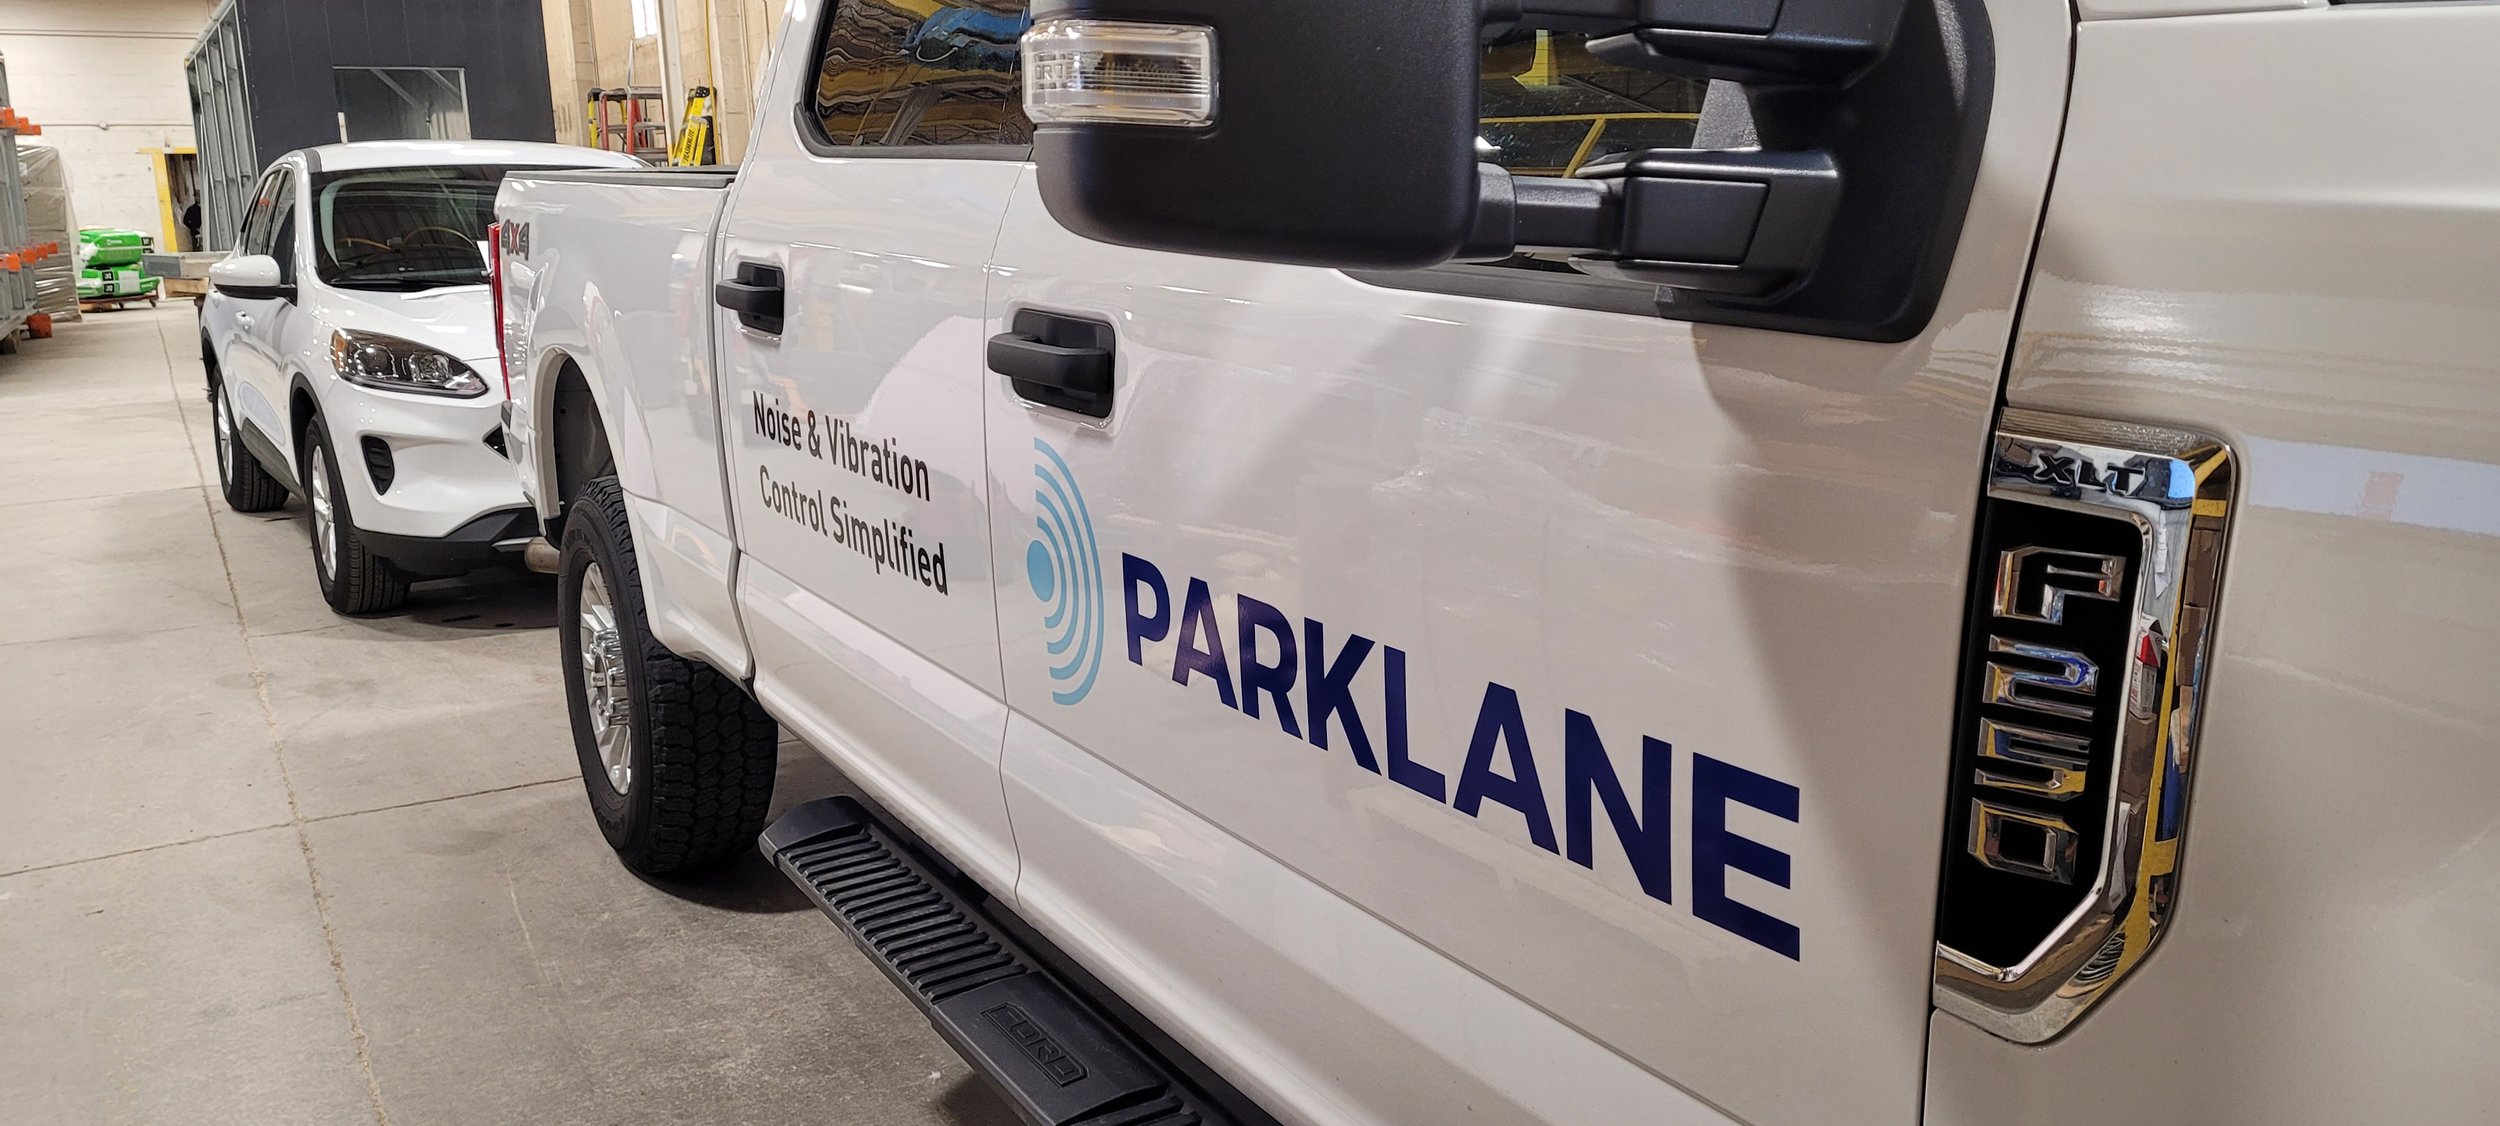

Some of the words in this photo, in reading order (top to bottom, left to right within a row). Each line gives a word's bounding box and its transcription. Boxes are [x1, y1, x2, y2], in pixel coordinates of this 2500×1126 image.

[753, 390, 802, 451] Noise
[807, 409, 823, 460] &
[825, 415, 930, 502] Vibration
[2034, 454, 2145, 495] XLT
[759, 464, 828, 537] Control
[831, 496, 948, 596] Simplified
[1122, 552, 1800, 962] PARKLANE
[980, 1002, 1090, 1088] FORD
